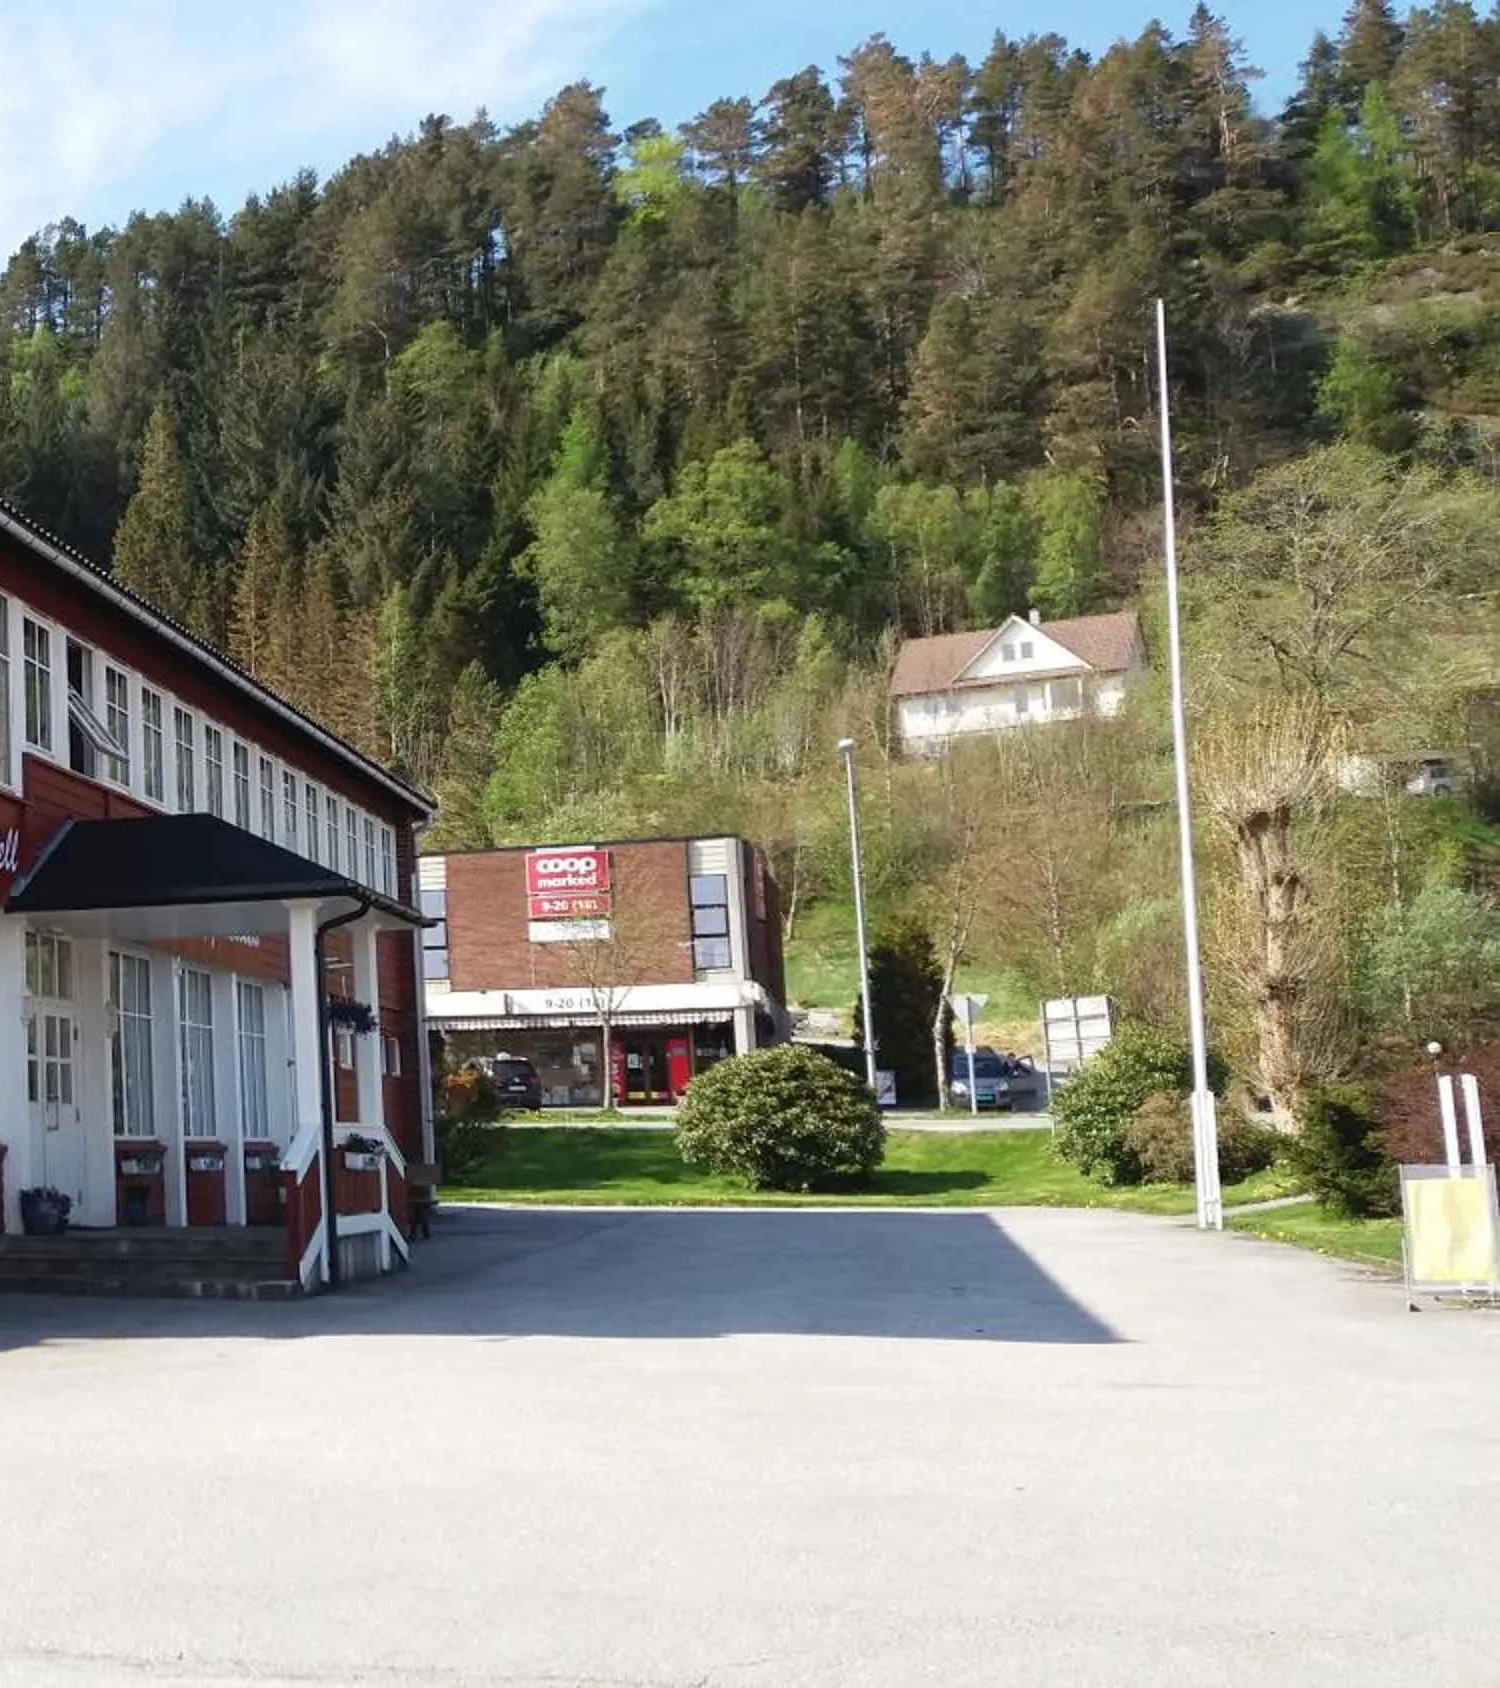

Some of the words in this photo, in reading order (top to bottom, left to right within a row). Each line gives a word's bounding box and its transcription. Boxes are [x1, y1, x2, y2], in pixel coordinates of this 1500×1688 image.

[536, 857, 597, 874] coop
[537, 872, 597, 889] marked
[541, 899, 569, 912] 9-20
[545, 997, 574, 1009] 9-20
